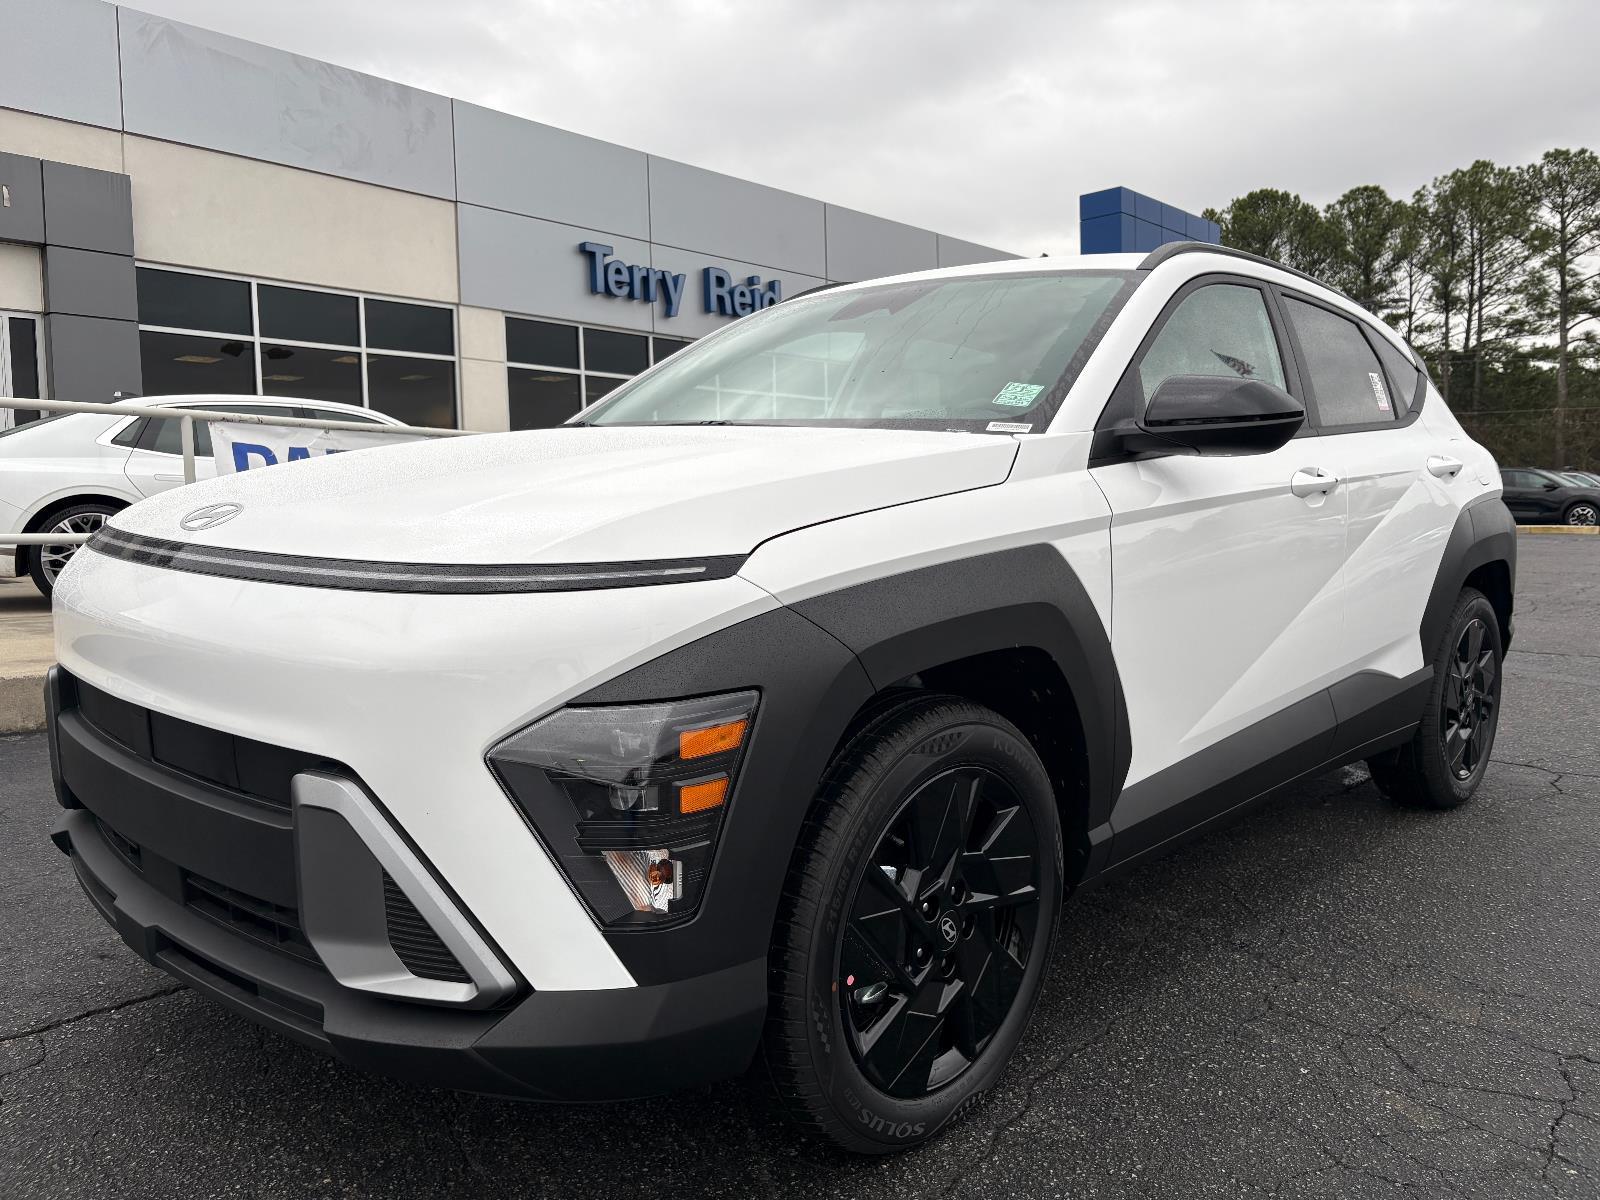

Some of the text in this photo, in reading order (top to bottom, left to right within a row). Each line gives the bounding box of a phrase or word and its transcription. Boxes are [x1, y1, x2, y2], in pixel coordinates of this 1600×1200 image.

[579, 242, 781, 317] Terry Reid
[856, 1108, 927, 1138] SOLUS
